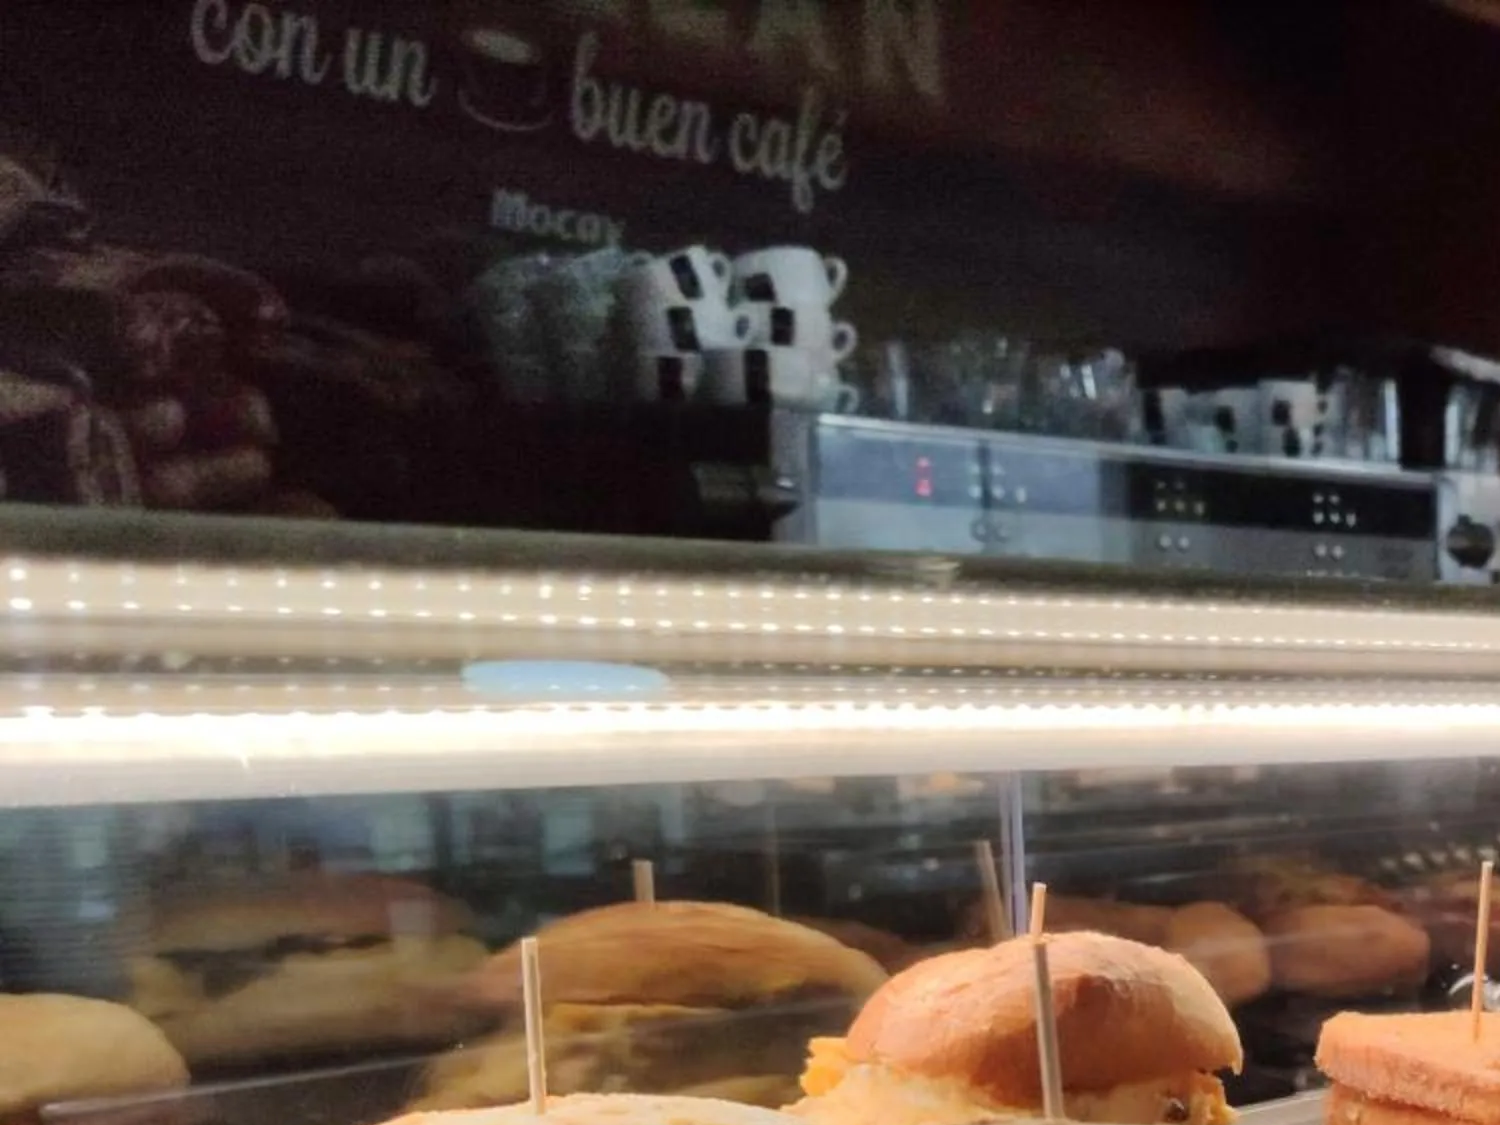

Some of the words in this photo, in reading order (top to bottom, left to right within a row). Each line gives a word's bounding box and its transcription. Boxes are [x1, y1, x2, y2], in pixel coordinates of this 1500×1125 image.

[343, 26, 438, 107] un
[569, 30, 717, 165] buen
[727, 86, 849, 215] café
